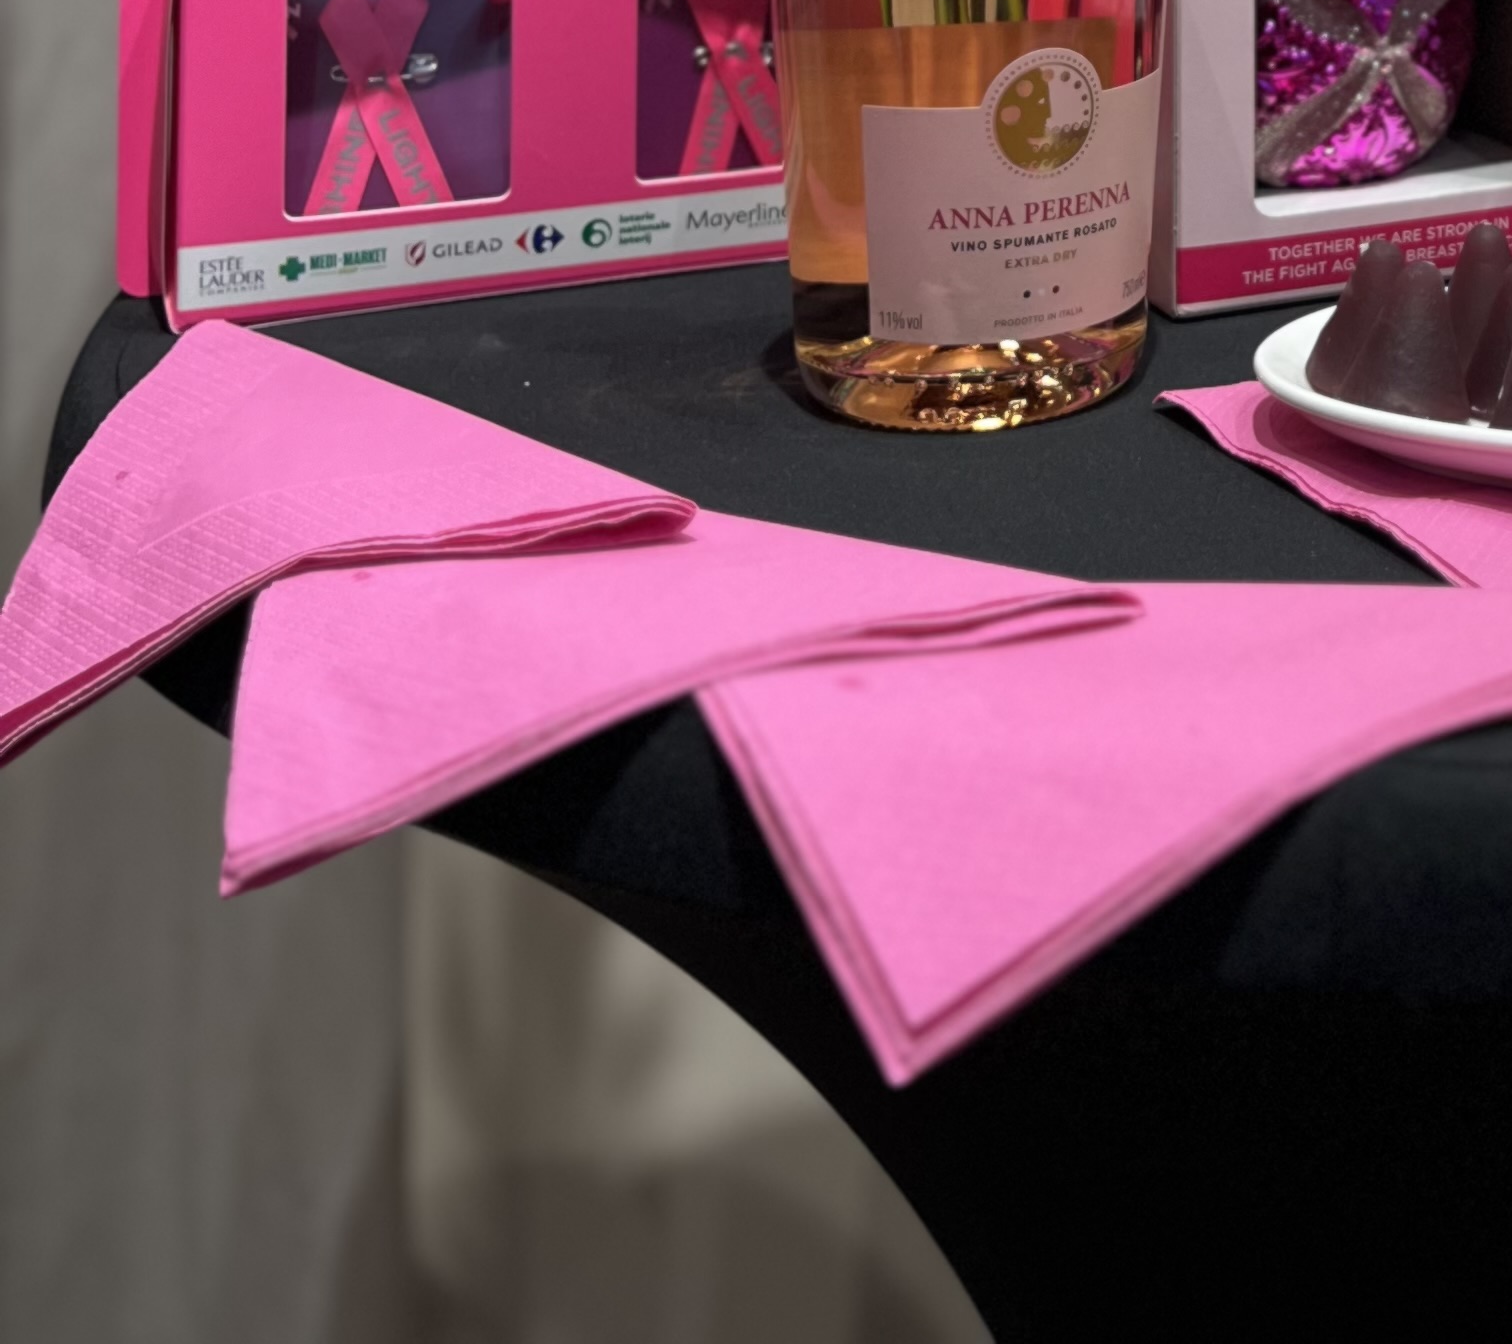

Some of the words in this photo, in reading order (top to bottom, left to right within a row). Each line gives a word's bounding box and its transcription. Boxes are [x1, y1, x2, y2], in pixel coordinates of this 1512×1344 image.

[928, 205, 1015, 230] ANNA
[1023, 181, 1131, 224] PERENNA
[951, 240, 988, 252] VINO
[993, 230, 1069, 250] SPUMANTE
[1074, 217, 1118, 237] ROSATO
[1269, 238, 1355, 261] TOGETHER
[1391, 228, 1422, 244] ARE
[433, 238, 503, 258] GILEAD
[1004, 255, 1049, 269] EXTRA
[1053, 248, 1078, 263] DRY
[199, 269, 265, 288] LAUDER
[1242, 269, 1274, 285] THE
[1280, 263, 1328, 280] FIGHT
[994, 315, 1044, 328] PRODOTTO
[1047, 313, 1056, 321] IN
[1059, 306, 1083, 320] ITALIA
